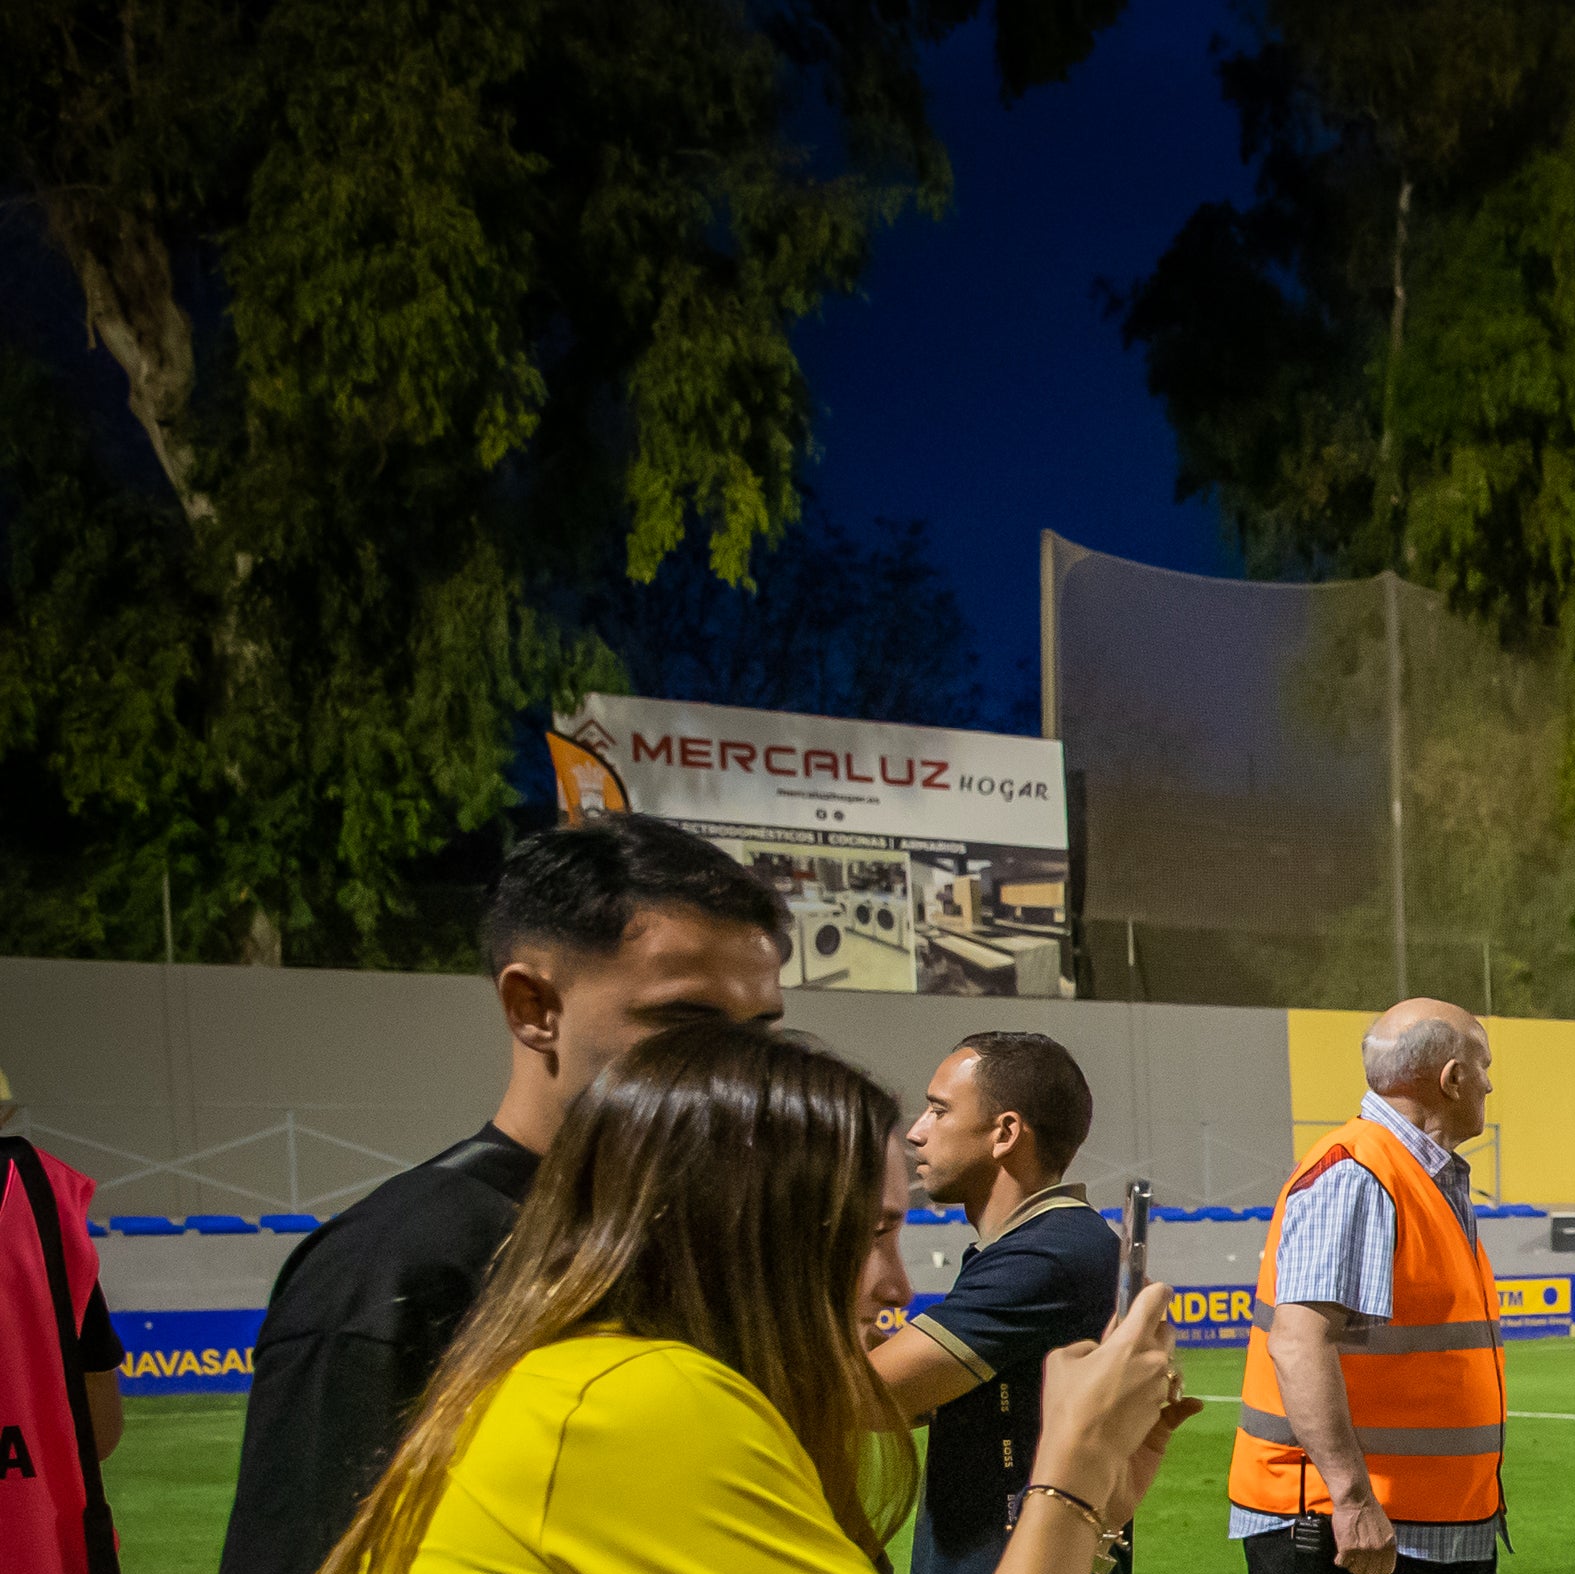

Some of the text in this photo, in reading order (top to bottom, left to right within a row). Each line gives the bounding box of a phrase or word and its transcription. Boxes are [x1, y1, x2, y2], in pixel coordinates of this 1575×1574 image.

[632, 732, 1050, 803] MERCALUZ HOGAR
[1003, 1439, 1014, 1468] BOSS
